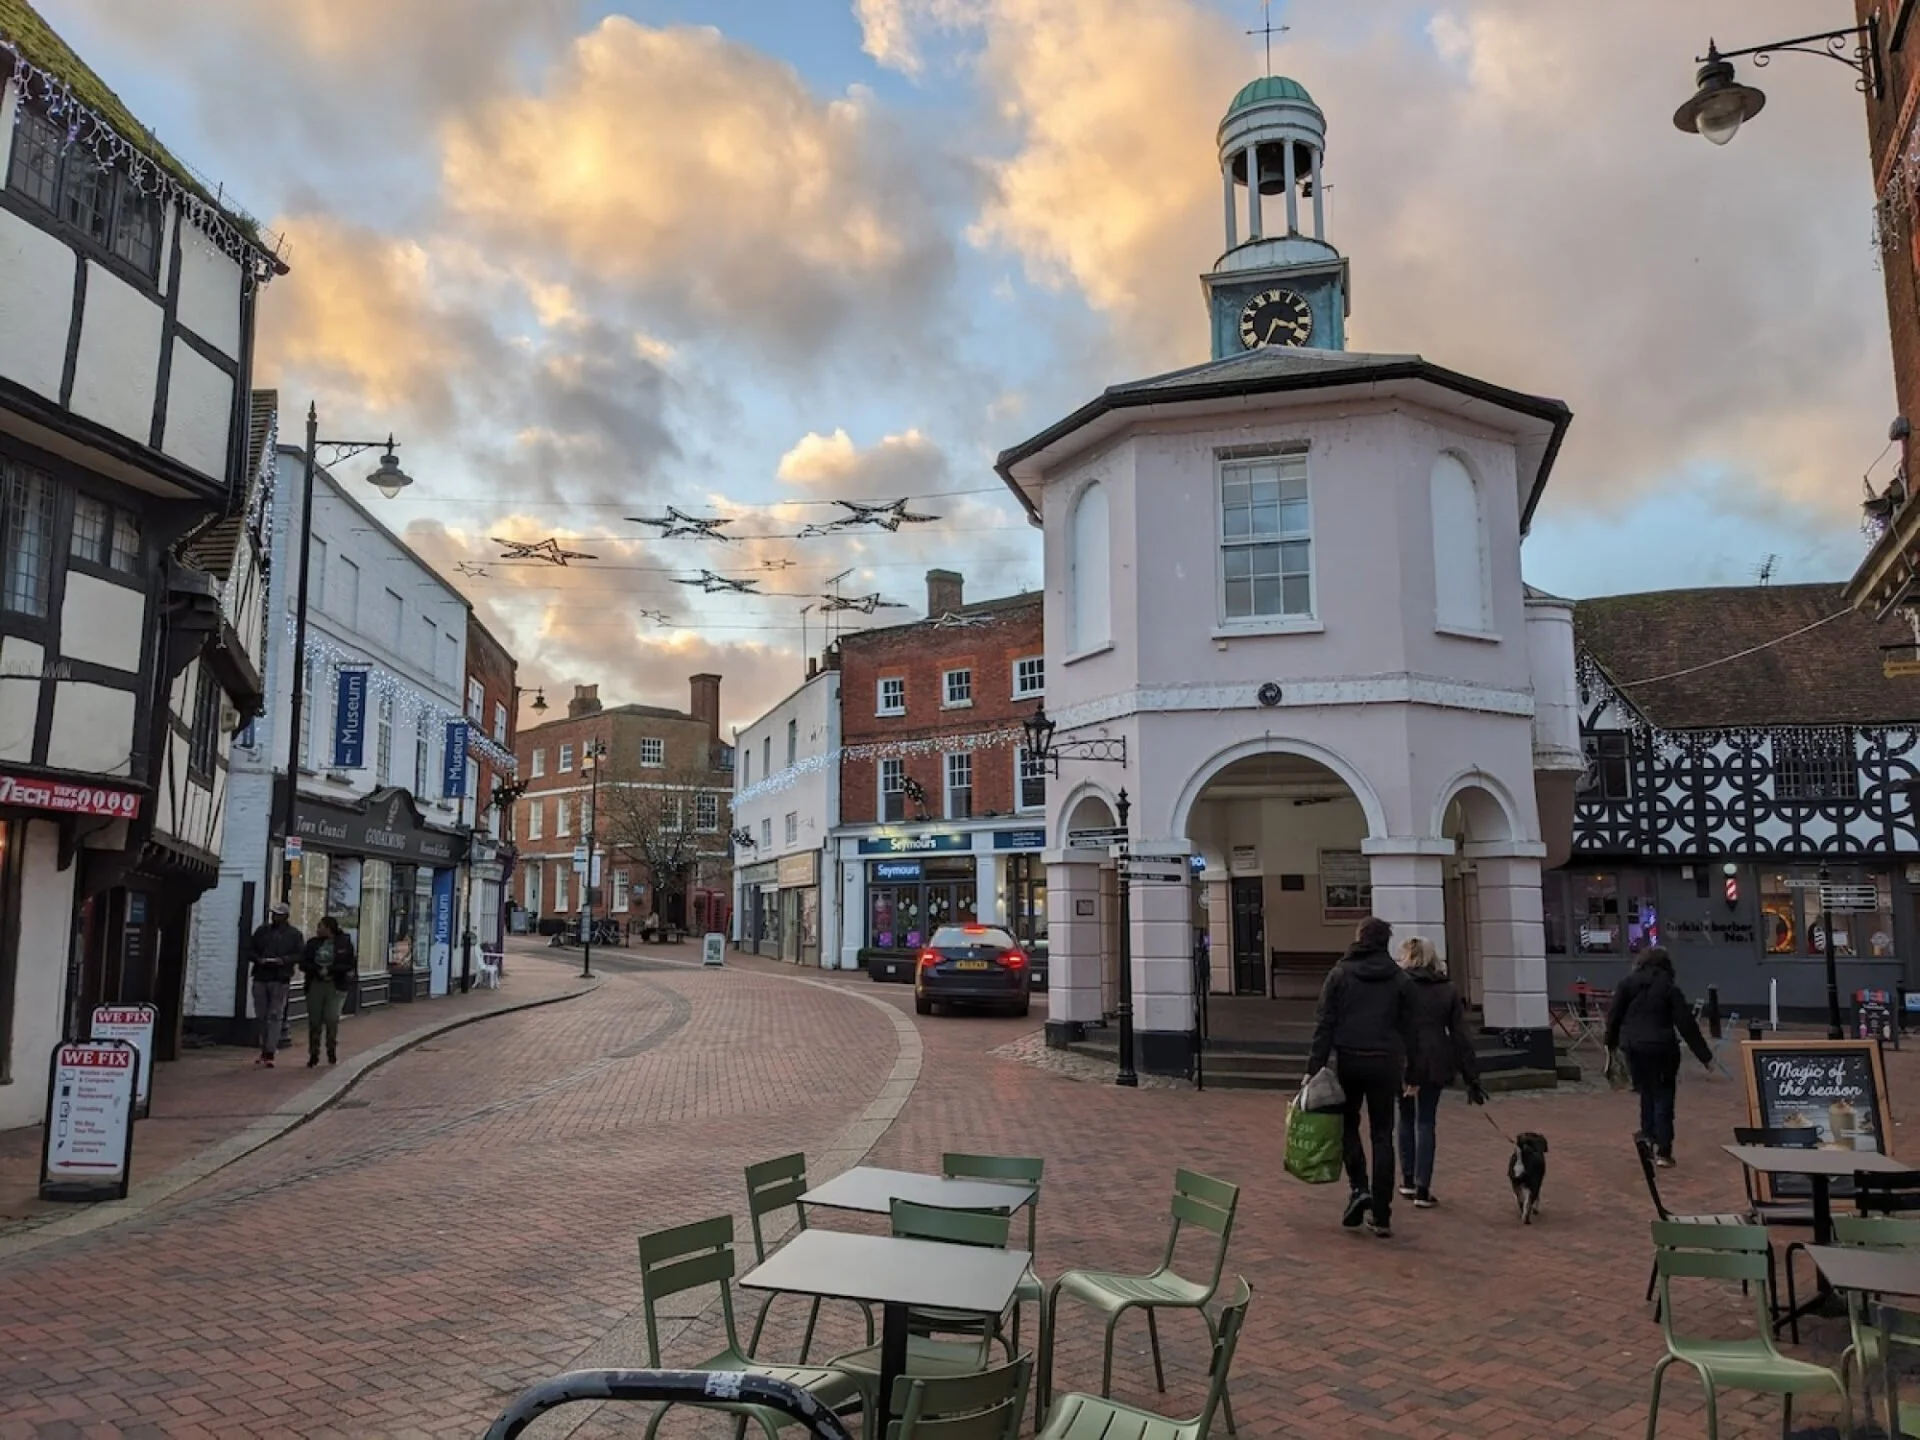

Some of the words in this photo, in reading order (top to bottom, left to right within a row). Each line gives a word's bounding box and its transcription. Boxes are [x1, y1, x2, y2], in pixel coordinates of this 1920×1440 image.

[341, 676, 361, 745] Museum
[448, 727, 465, 780] Museum
[0, 776, 50, 806] TECH
[296, 815, 315, 834] Town
[318, 819, 348, 839] Council
[890, 837, 937, 852] Seymours
[877, 864, 921, 879] Seymours
[434, 894, 449, 945] Museum
[1712, 920, 1753, 932] barber
[98, 1011, 121, 1022] WE
[126, 1011, 150, 1022] FIX
[63, 1051, 95, 1065] WE
[98, 1052, 127, 1066] FIX
[1768, 1061, 1825, 1085] Magic
[1828, 1058, 1847, 1085] of
[1778, 1080, 1805, 1096] the
[1808, 1085, 1863, 1096] season
